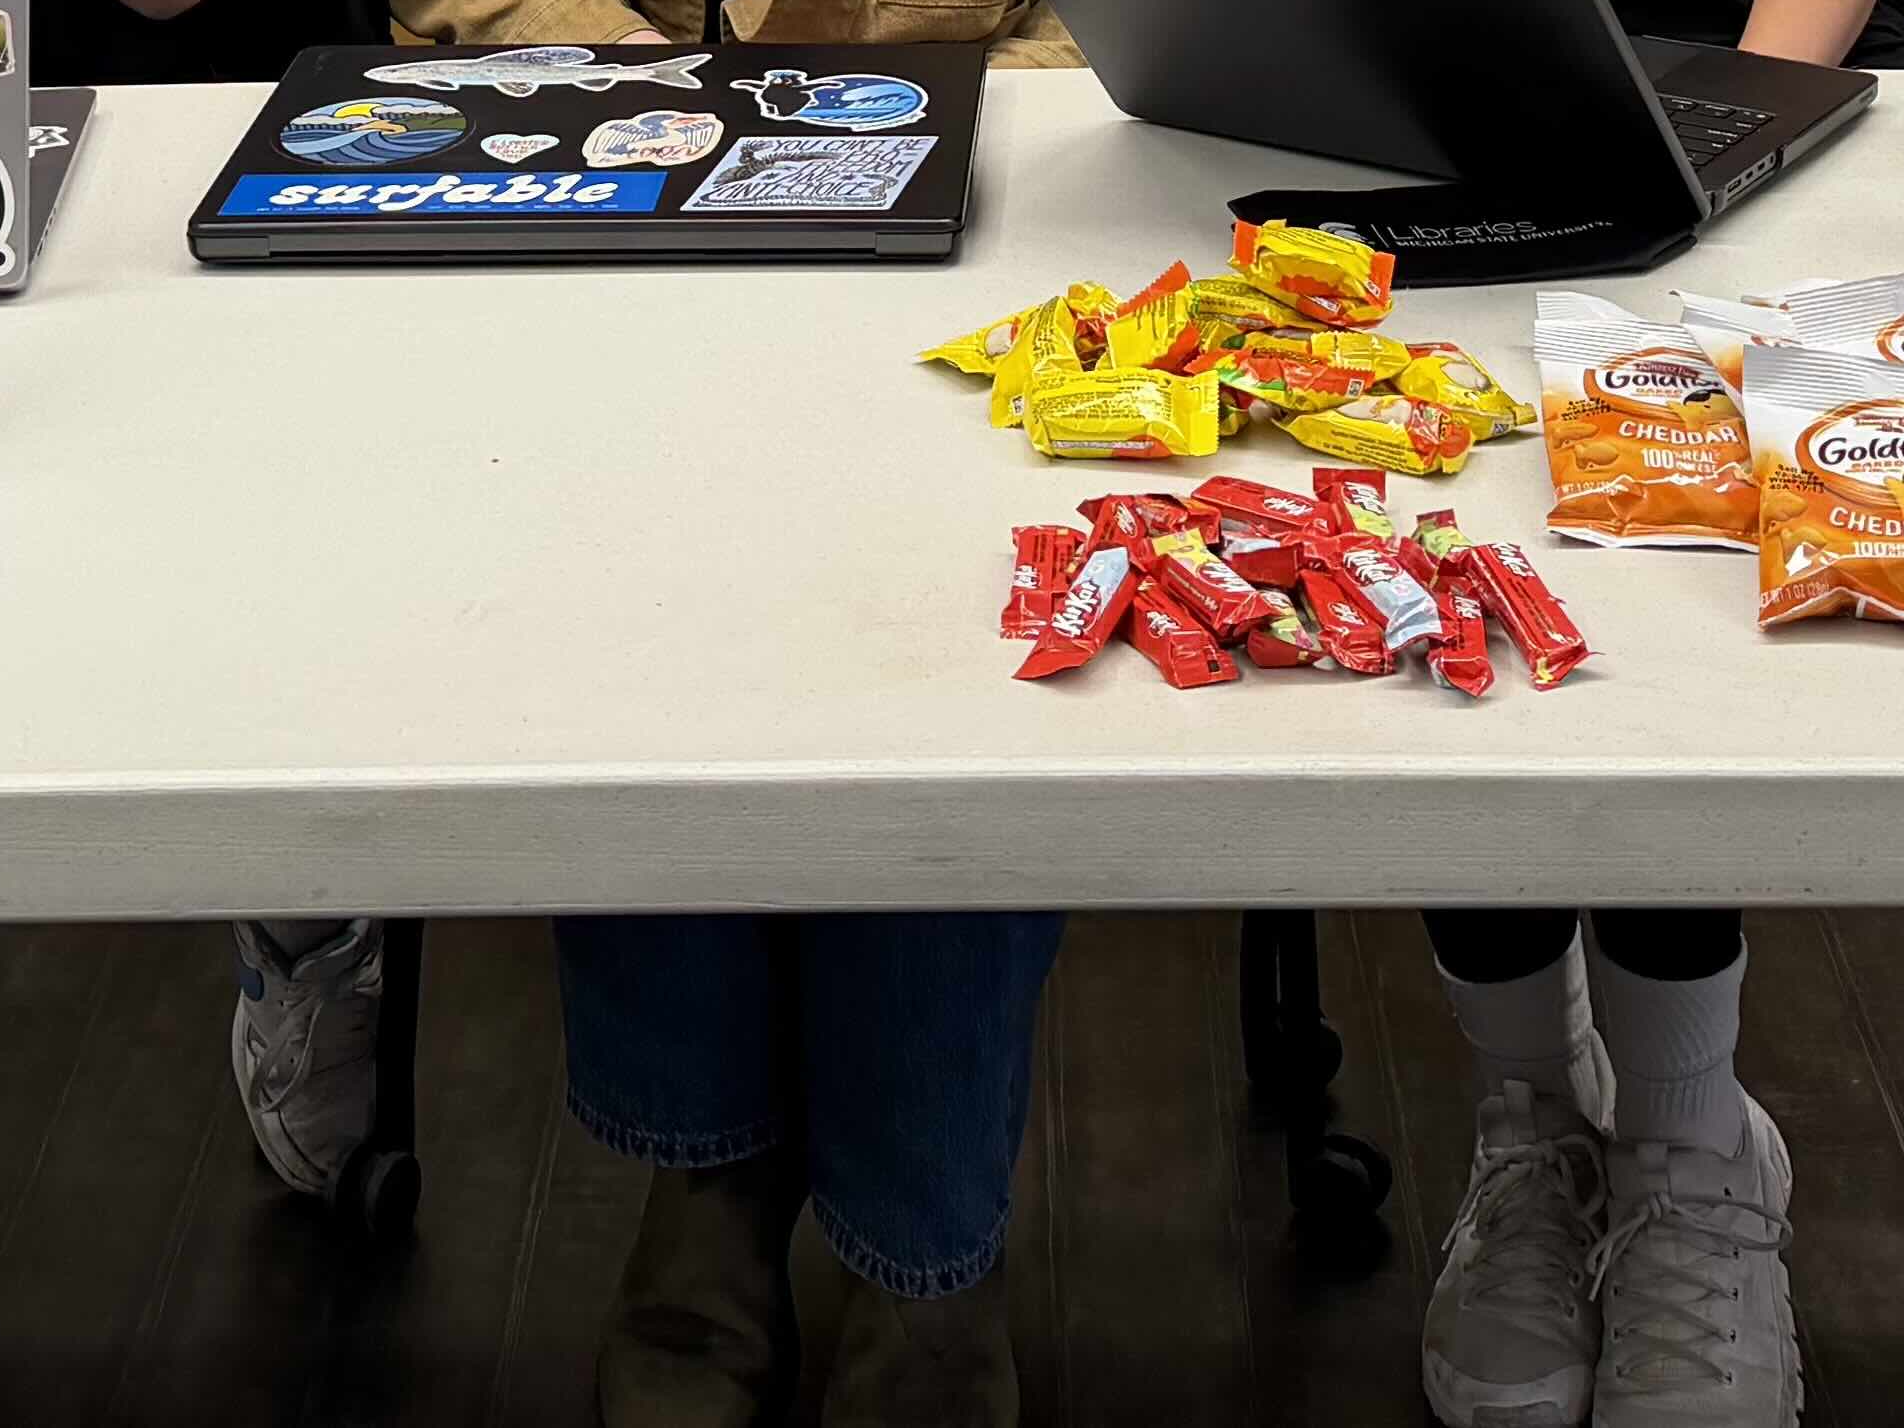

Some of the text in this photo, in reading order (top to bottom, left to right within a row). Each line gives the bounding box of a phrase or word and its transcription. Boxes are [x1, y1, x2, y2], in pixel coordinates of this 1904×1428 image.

[268, 173, 619, 211] surfable
[1386, 220, 1537, 242] Libraries
[1618, 420, 1739, 445] CHEDDAR
